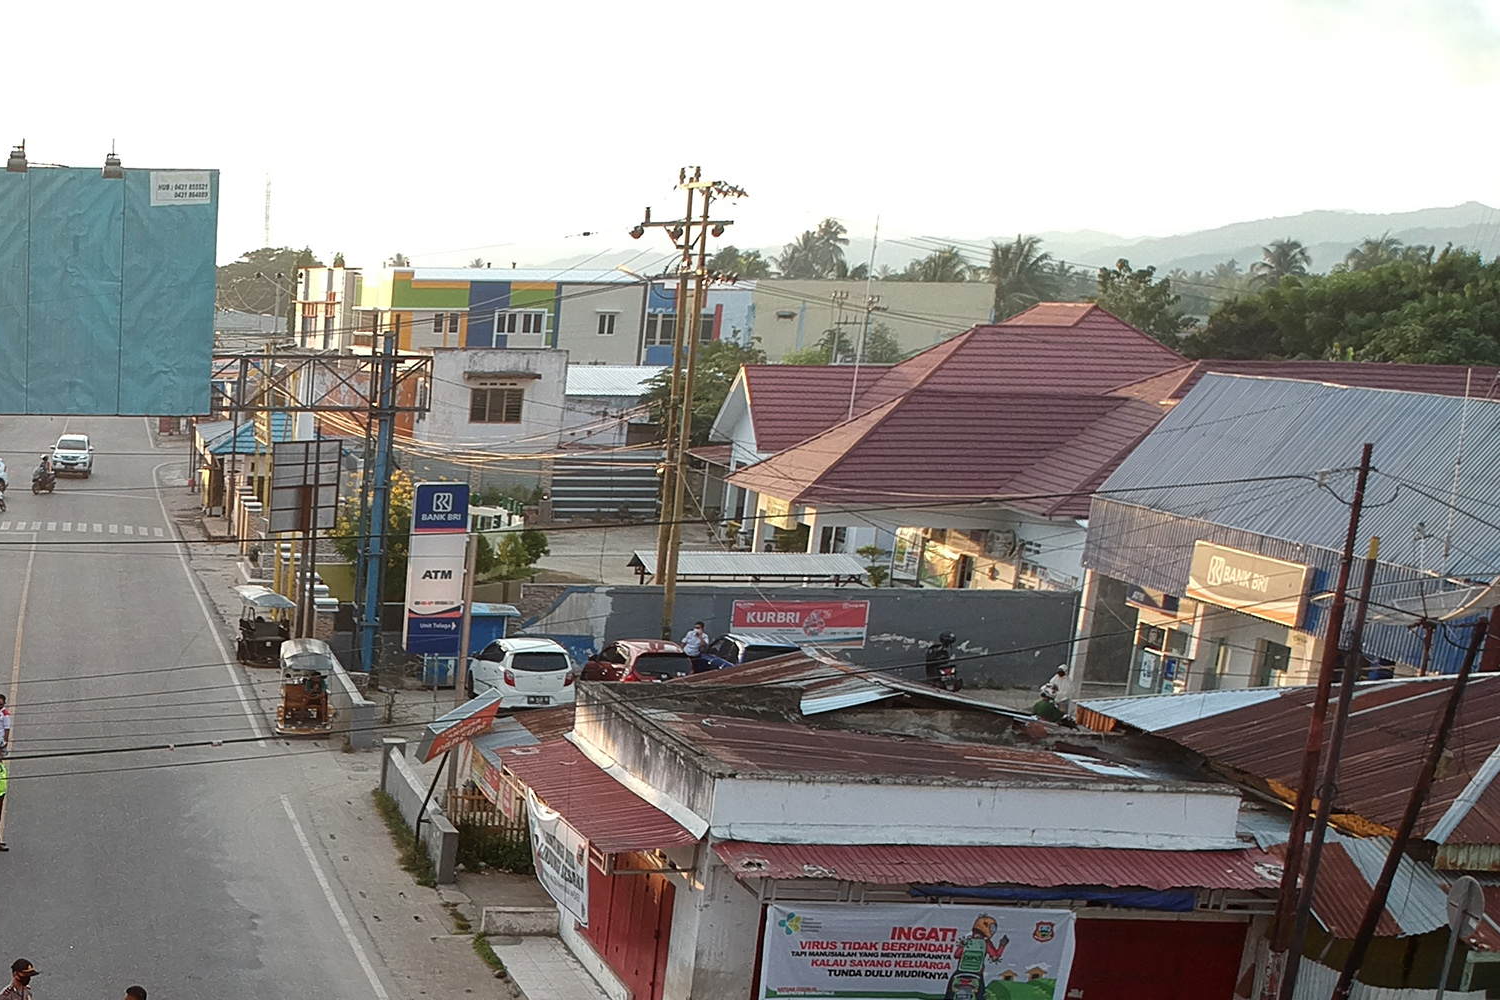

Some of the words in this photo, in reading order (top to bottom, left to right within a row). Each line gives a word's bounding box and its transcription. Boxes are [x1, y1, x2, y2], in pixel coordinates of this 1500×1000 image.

[447, 513, 462, 521] BRI
[422, 570, 452, 580] ATM
[1222, 566, 1251, 588] BANK
[1250, 573, 1270, 593] BRI
[746, 612, 800, 623] KURBRI
[890, 926, 958, 942] INGAT!
[800, 941, 838, 950] VIRUS
[841, 942, 879, 951] TIDAK
[882, 942, 954, 953] BERPINDAH
[811, 959, 847, 967] KALAU
[849, 959, 892, 968] SAYANG
[894, 960, 951, 970] KELUARGA
[828, 969, 863, 978] TUNDA
[864, 969, 893, 978] DULU
[894, 970, 949, 980] MUDIKNYA
